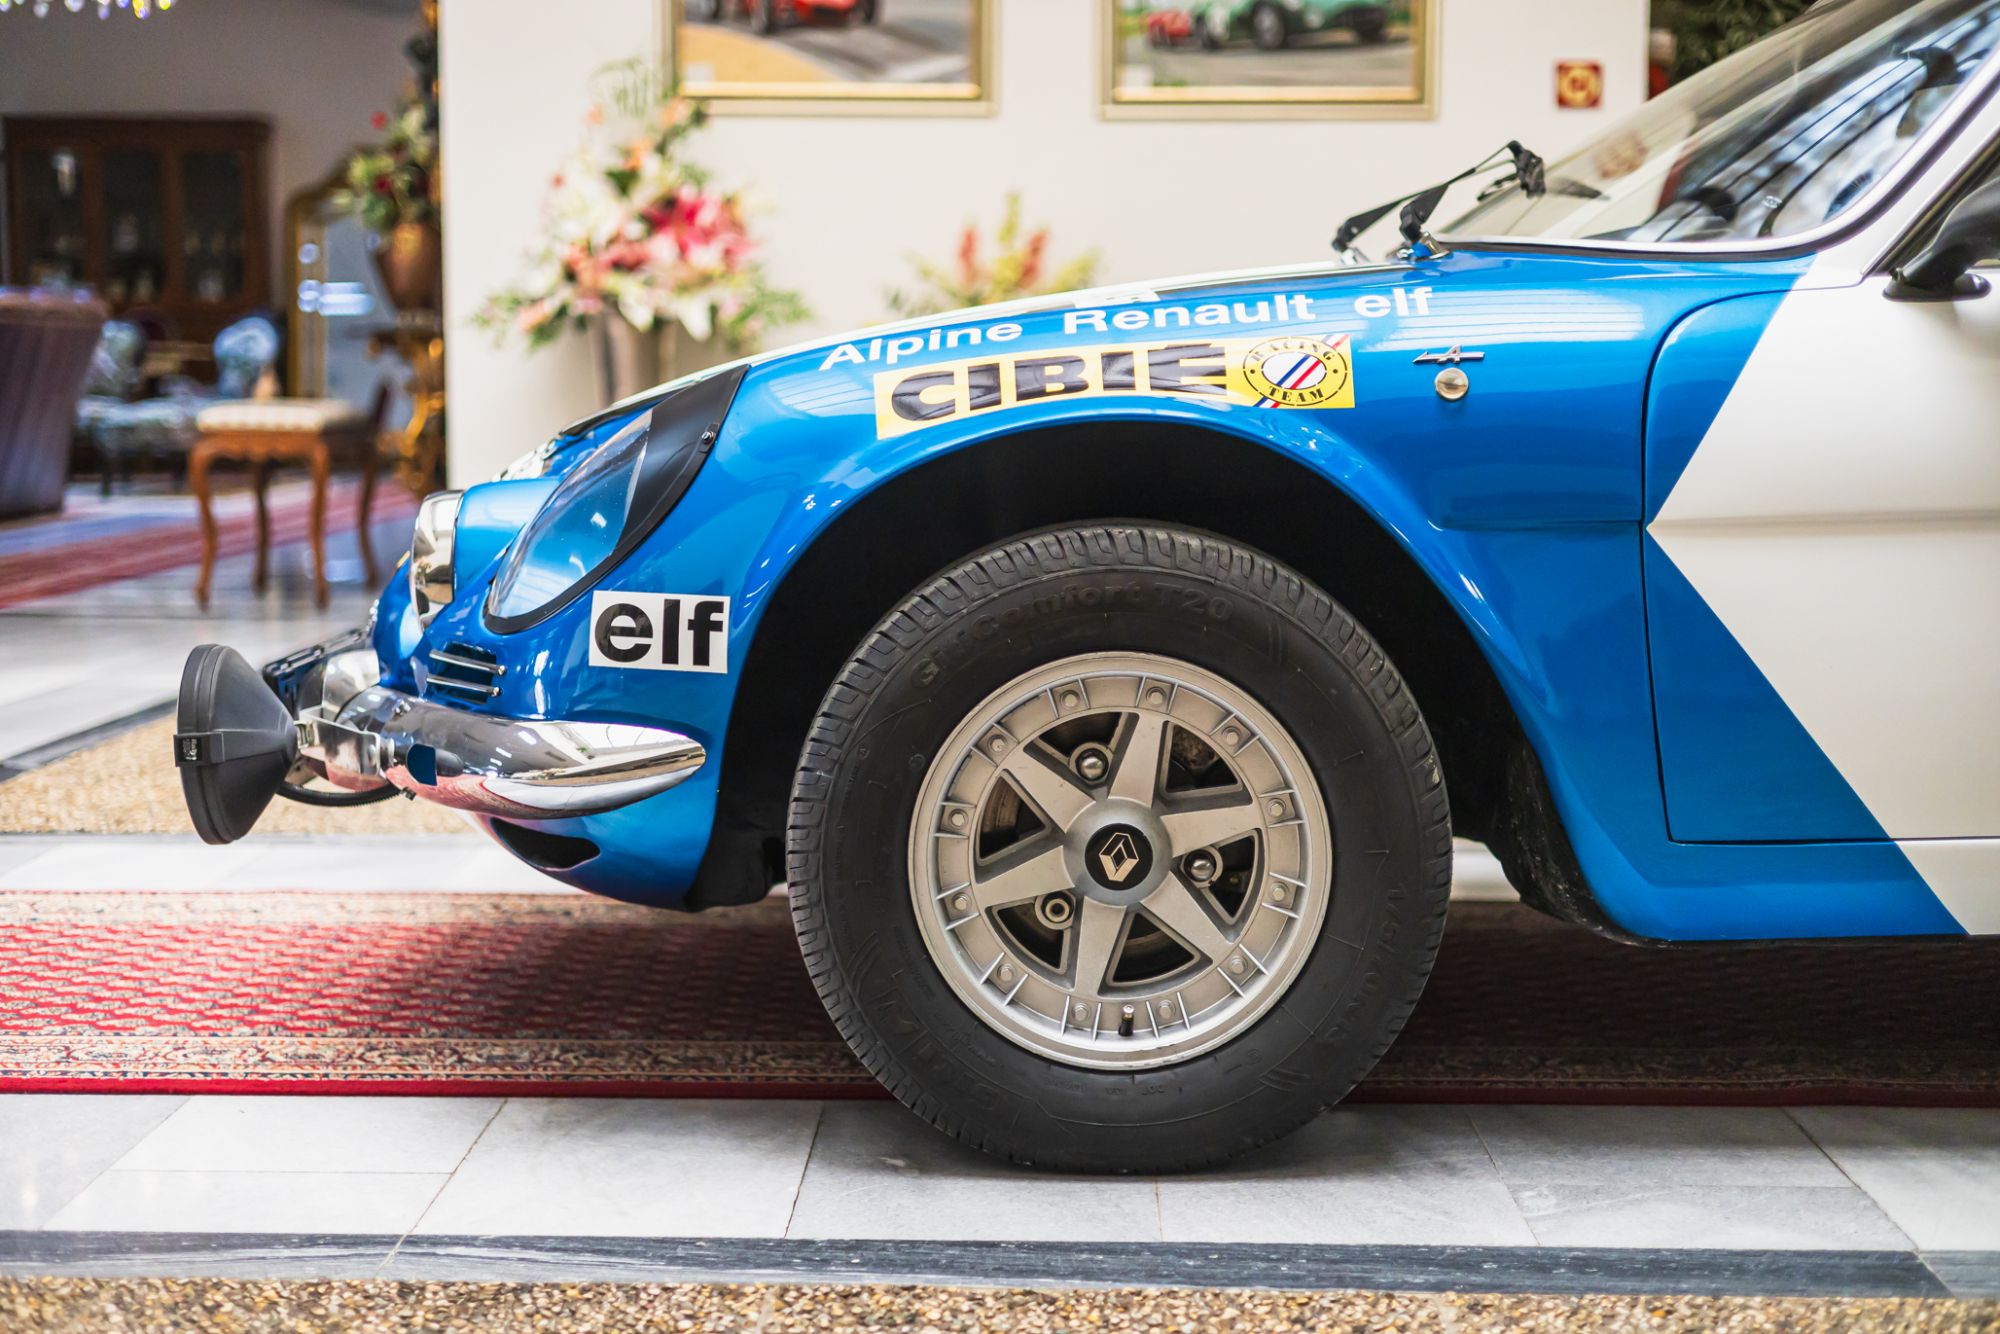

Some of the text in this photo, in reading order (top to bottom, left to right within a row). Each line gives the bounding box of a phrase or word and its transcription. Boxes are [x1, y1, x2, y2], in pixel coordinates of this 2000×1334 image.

[818, 286, 1433, 372] Alpine Renault elf
[1251, 341, 1335, 362] RACING
[1269, 386, 1324, 403] TEAM
[1154, 582, 1234, 622] T20
[594, 598, 725, 667] elf
